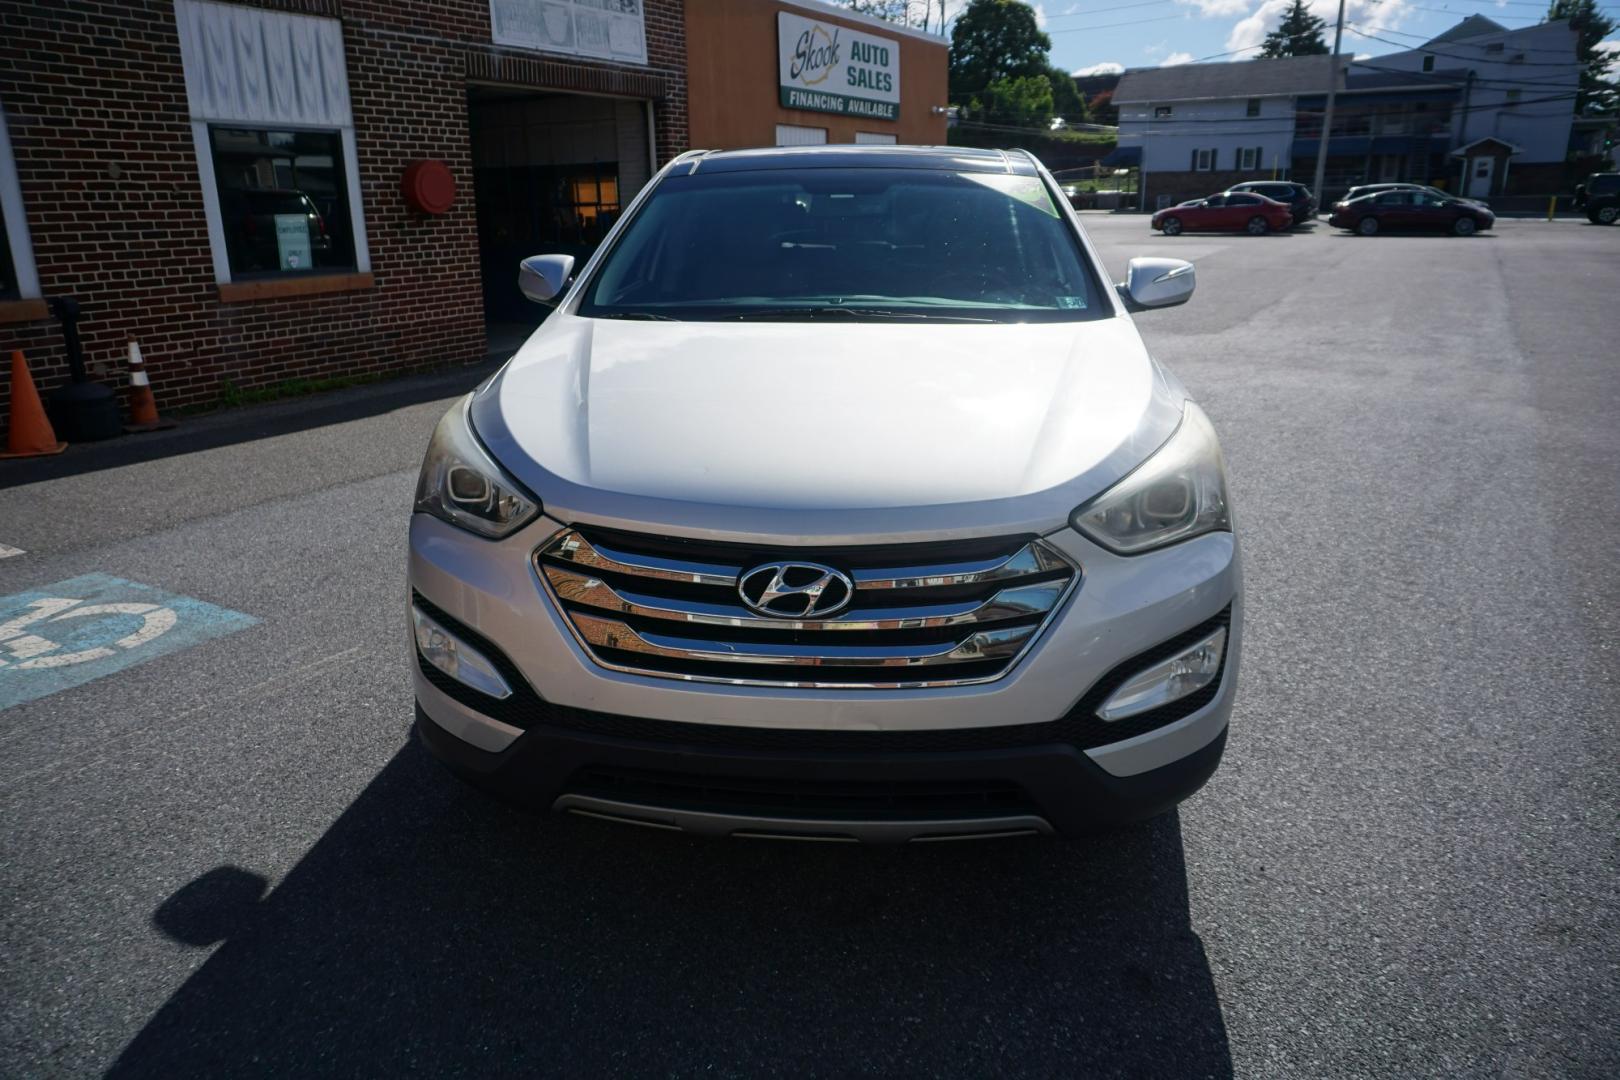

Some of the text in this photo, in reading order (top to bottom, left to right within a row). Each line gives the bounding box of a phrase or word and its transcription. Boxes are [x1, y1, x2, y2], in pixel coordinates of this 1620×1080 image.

[790, 28, 840, 80] Skook
[851, 41, 889, 67] AUTO
[847, 66, 892, 92] SALES
[790, 91, 893, 117] FINANCING AVAILABLE
